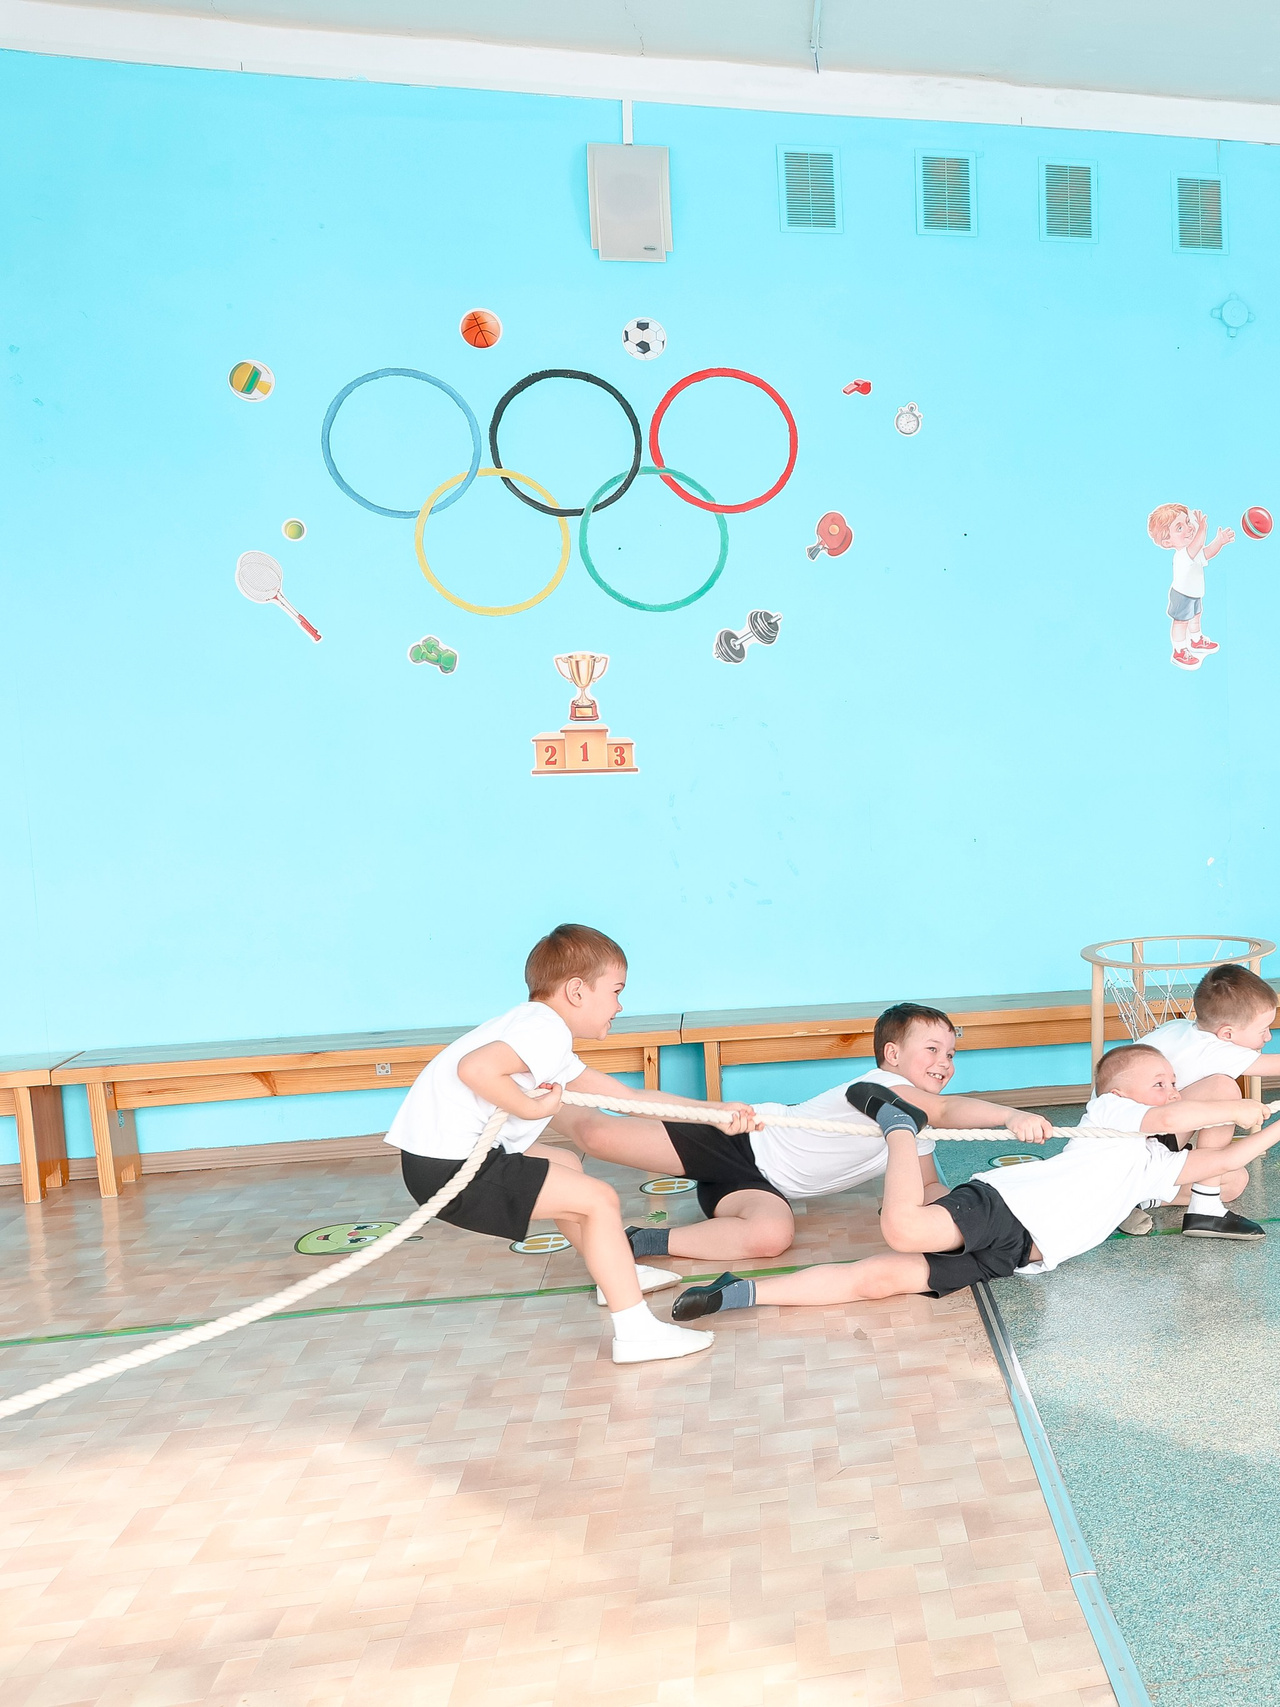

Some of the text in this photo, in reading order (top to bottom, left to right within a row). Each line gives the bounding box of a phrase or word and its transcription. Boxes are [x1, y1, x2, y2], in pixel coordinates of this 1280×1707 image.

[544, 742, 626, 766] 2 1 3
